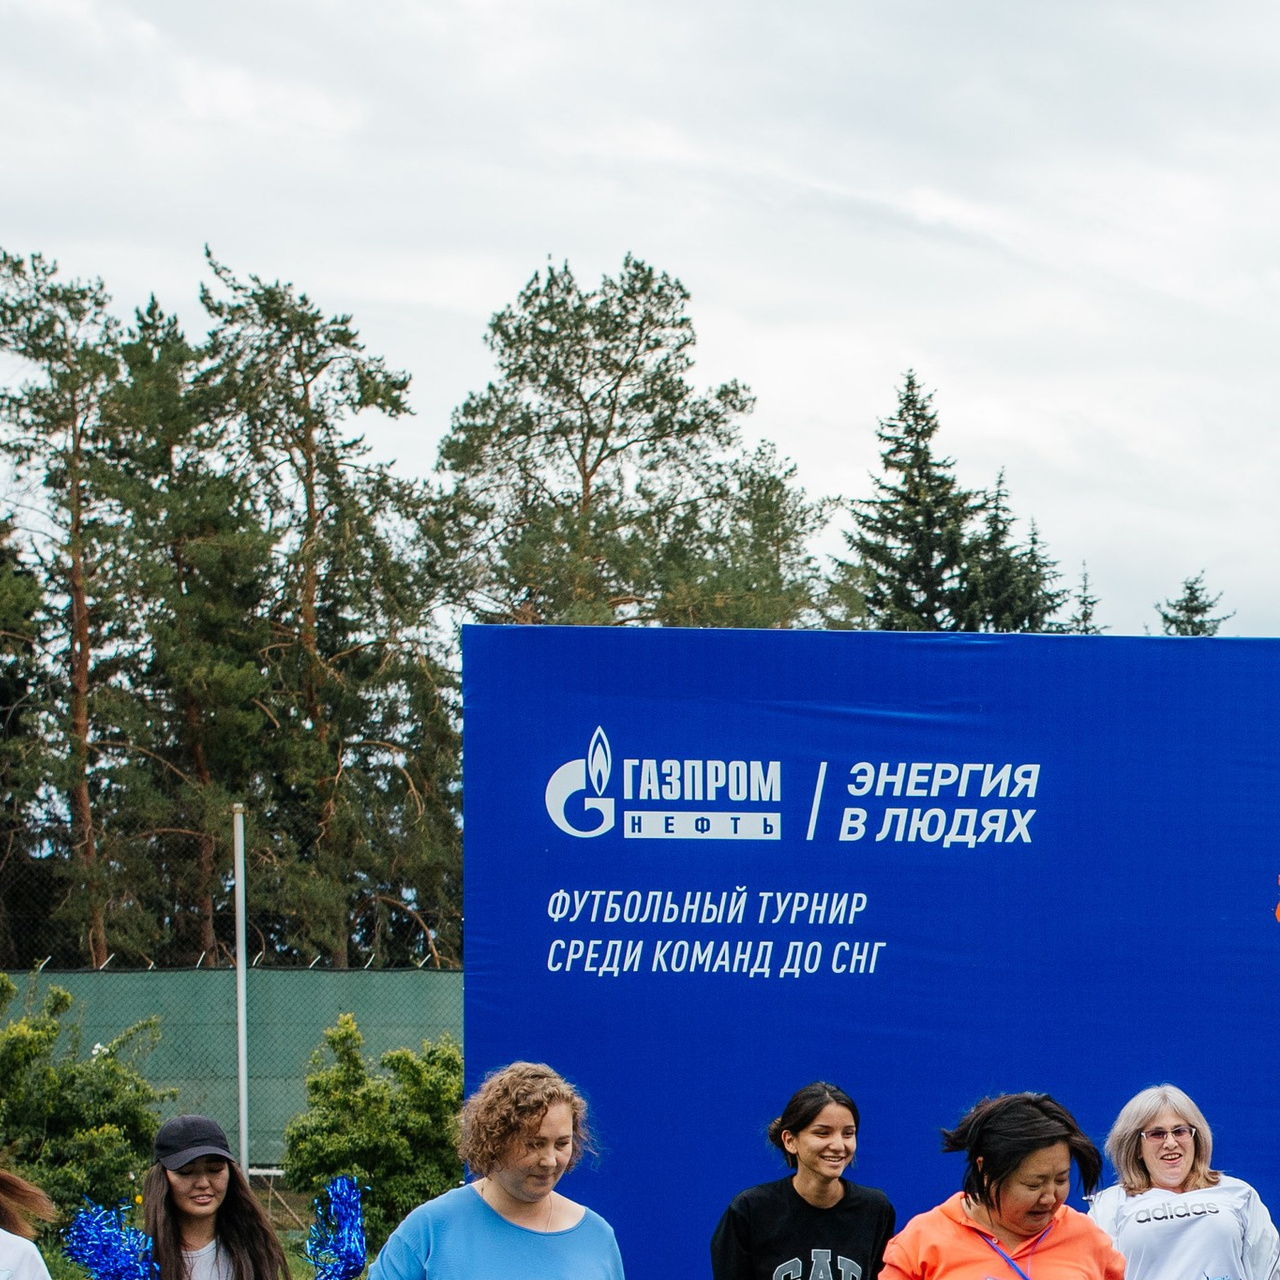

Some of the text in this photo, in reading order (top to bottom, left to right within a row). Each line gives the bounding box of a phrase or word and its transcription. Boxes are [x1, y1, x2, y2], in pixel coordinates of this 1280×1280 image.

[623, 758, 781, 802] ГАЗПРОМ
[847, 761, 1041, 798] ЭНЕРГИЯ
[631, 816, 775, 835] НЕФТЬ
[838, 807, 1037, 849] В ЛЮДЯХ
[547, 885, 867, 925] ФУТБОЛЬНЫЙ ТУРНИР
[547, 939, 887, 979] СРЕДИ КОМАНД ДО СНГ
[1135, 1201, 1220, 1224] adidas
